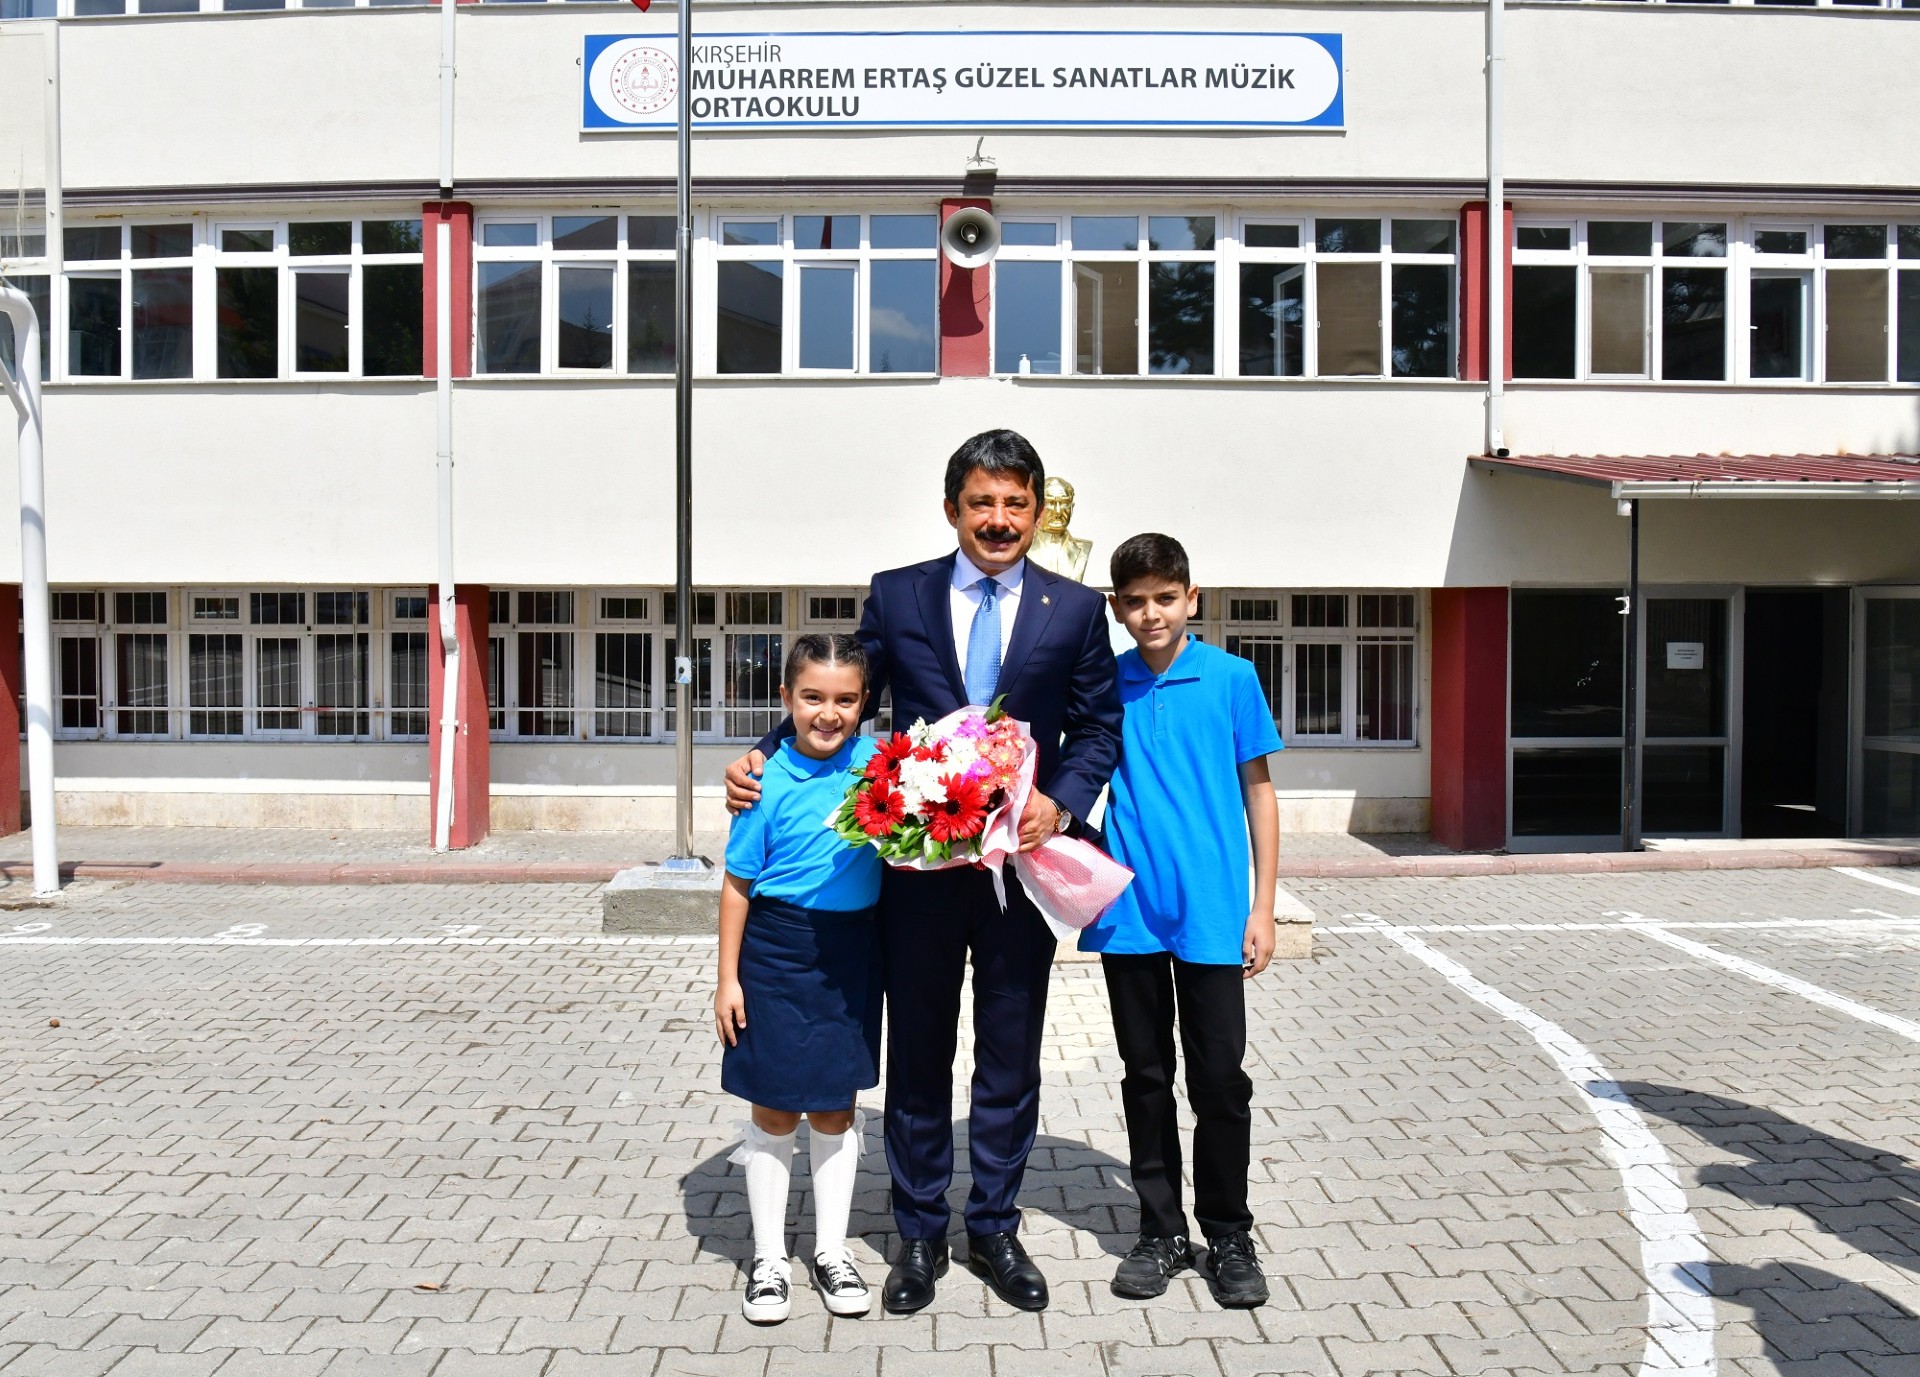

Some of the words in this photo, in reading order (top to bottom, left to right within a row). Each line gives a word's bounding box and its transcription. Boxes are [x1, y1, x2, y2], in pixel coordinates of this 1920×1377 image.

[692, 42, 780, 68] KIRŞEHİR
[692, 69, 854, 89] MUHARREM
[865, 68, 946, 94] ERTAŞ
[955, 63, 1044, 87] GÜZEL
[1053, 68, 1197, 88] SANATLAR
[1206, 63, 1295, 89] MÜZİK
[692, 97, 859, 118] ORTAOKULU
